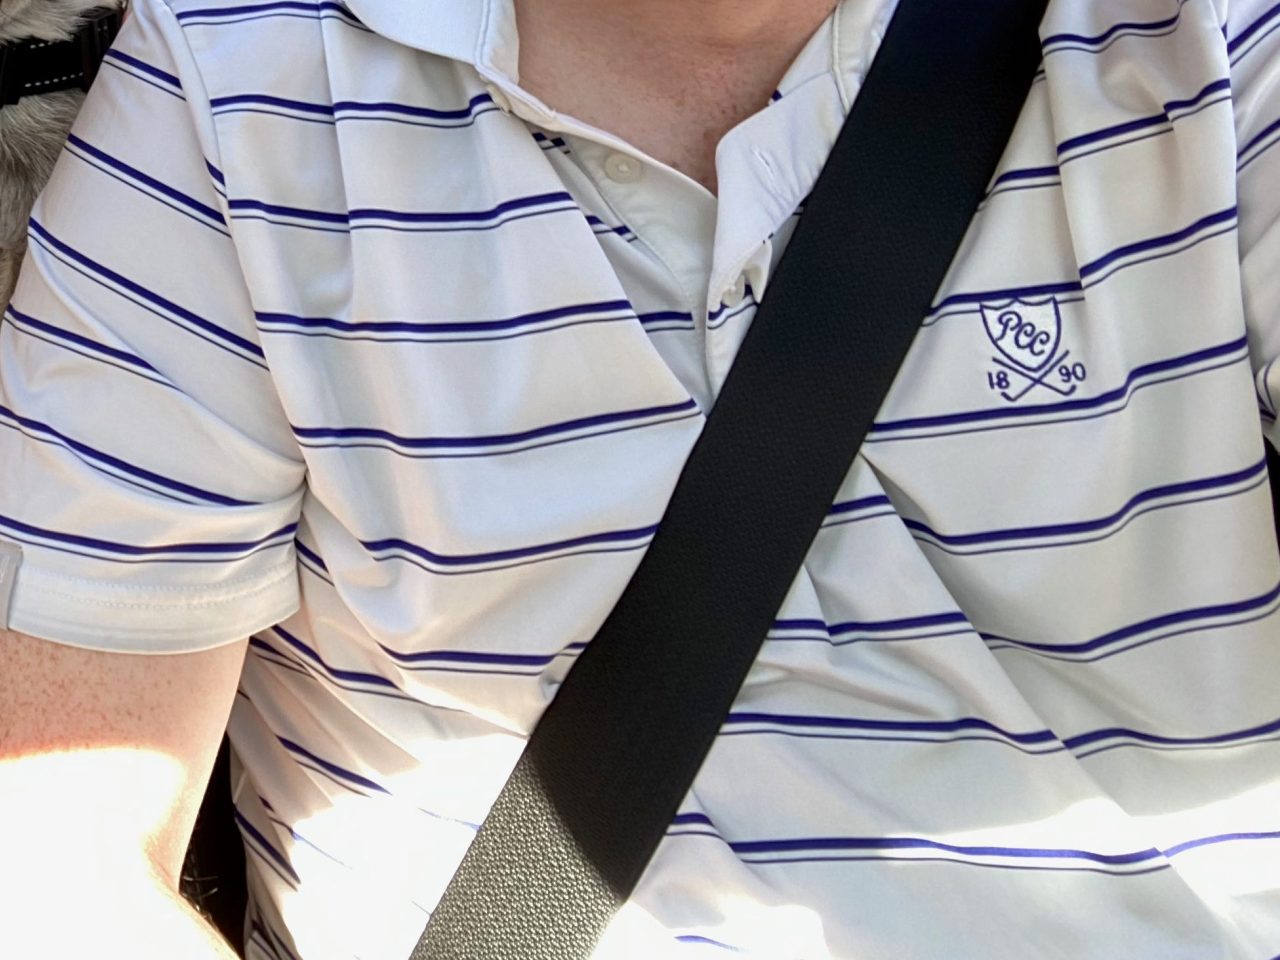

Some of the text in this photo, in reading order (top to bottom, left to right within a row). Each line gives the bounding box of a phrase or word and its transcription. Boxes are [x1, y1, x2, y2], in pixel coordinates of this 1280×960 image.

[995, 310, 1051, 357] PCC
[987, 362, 1087, 390] 18 90
